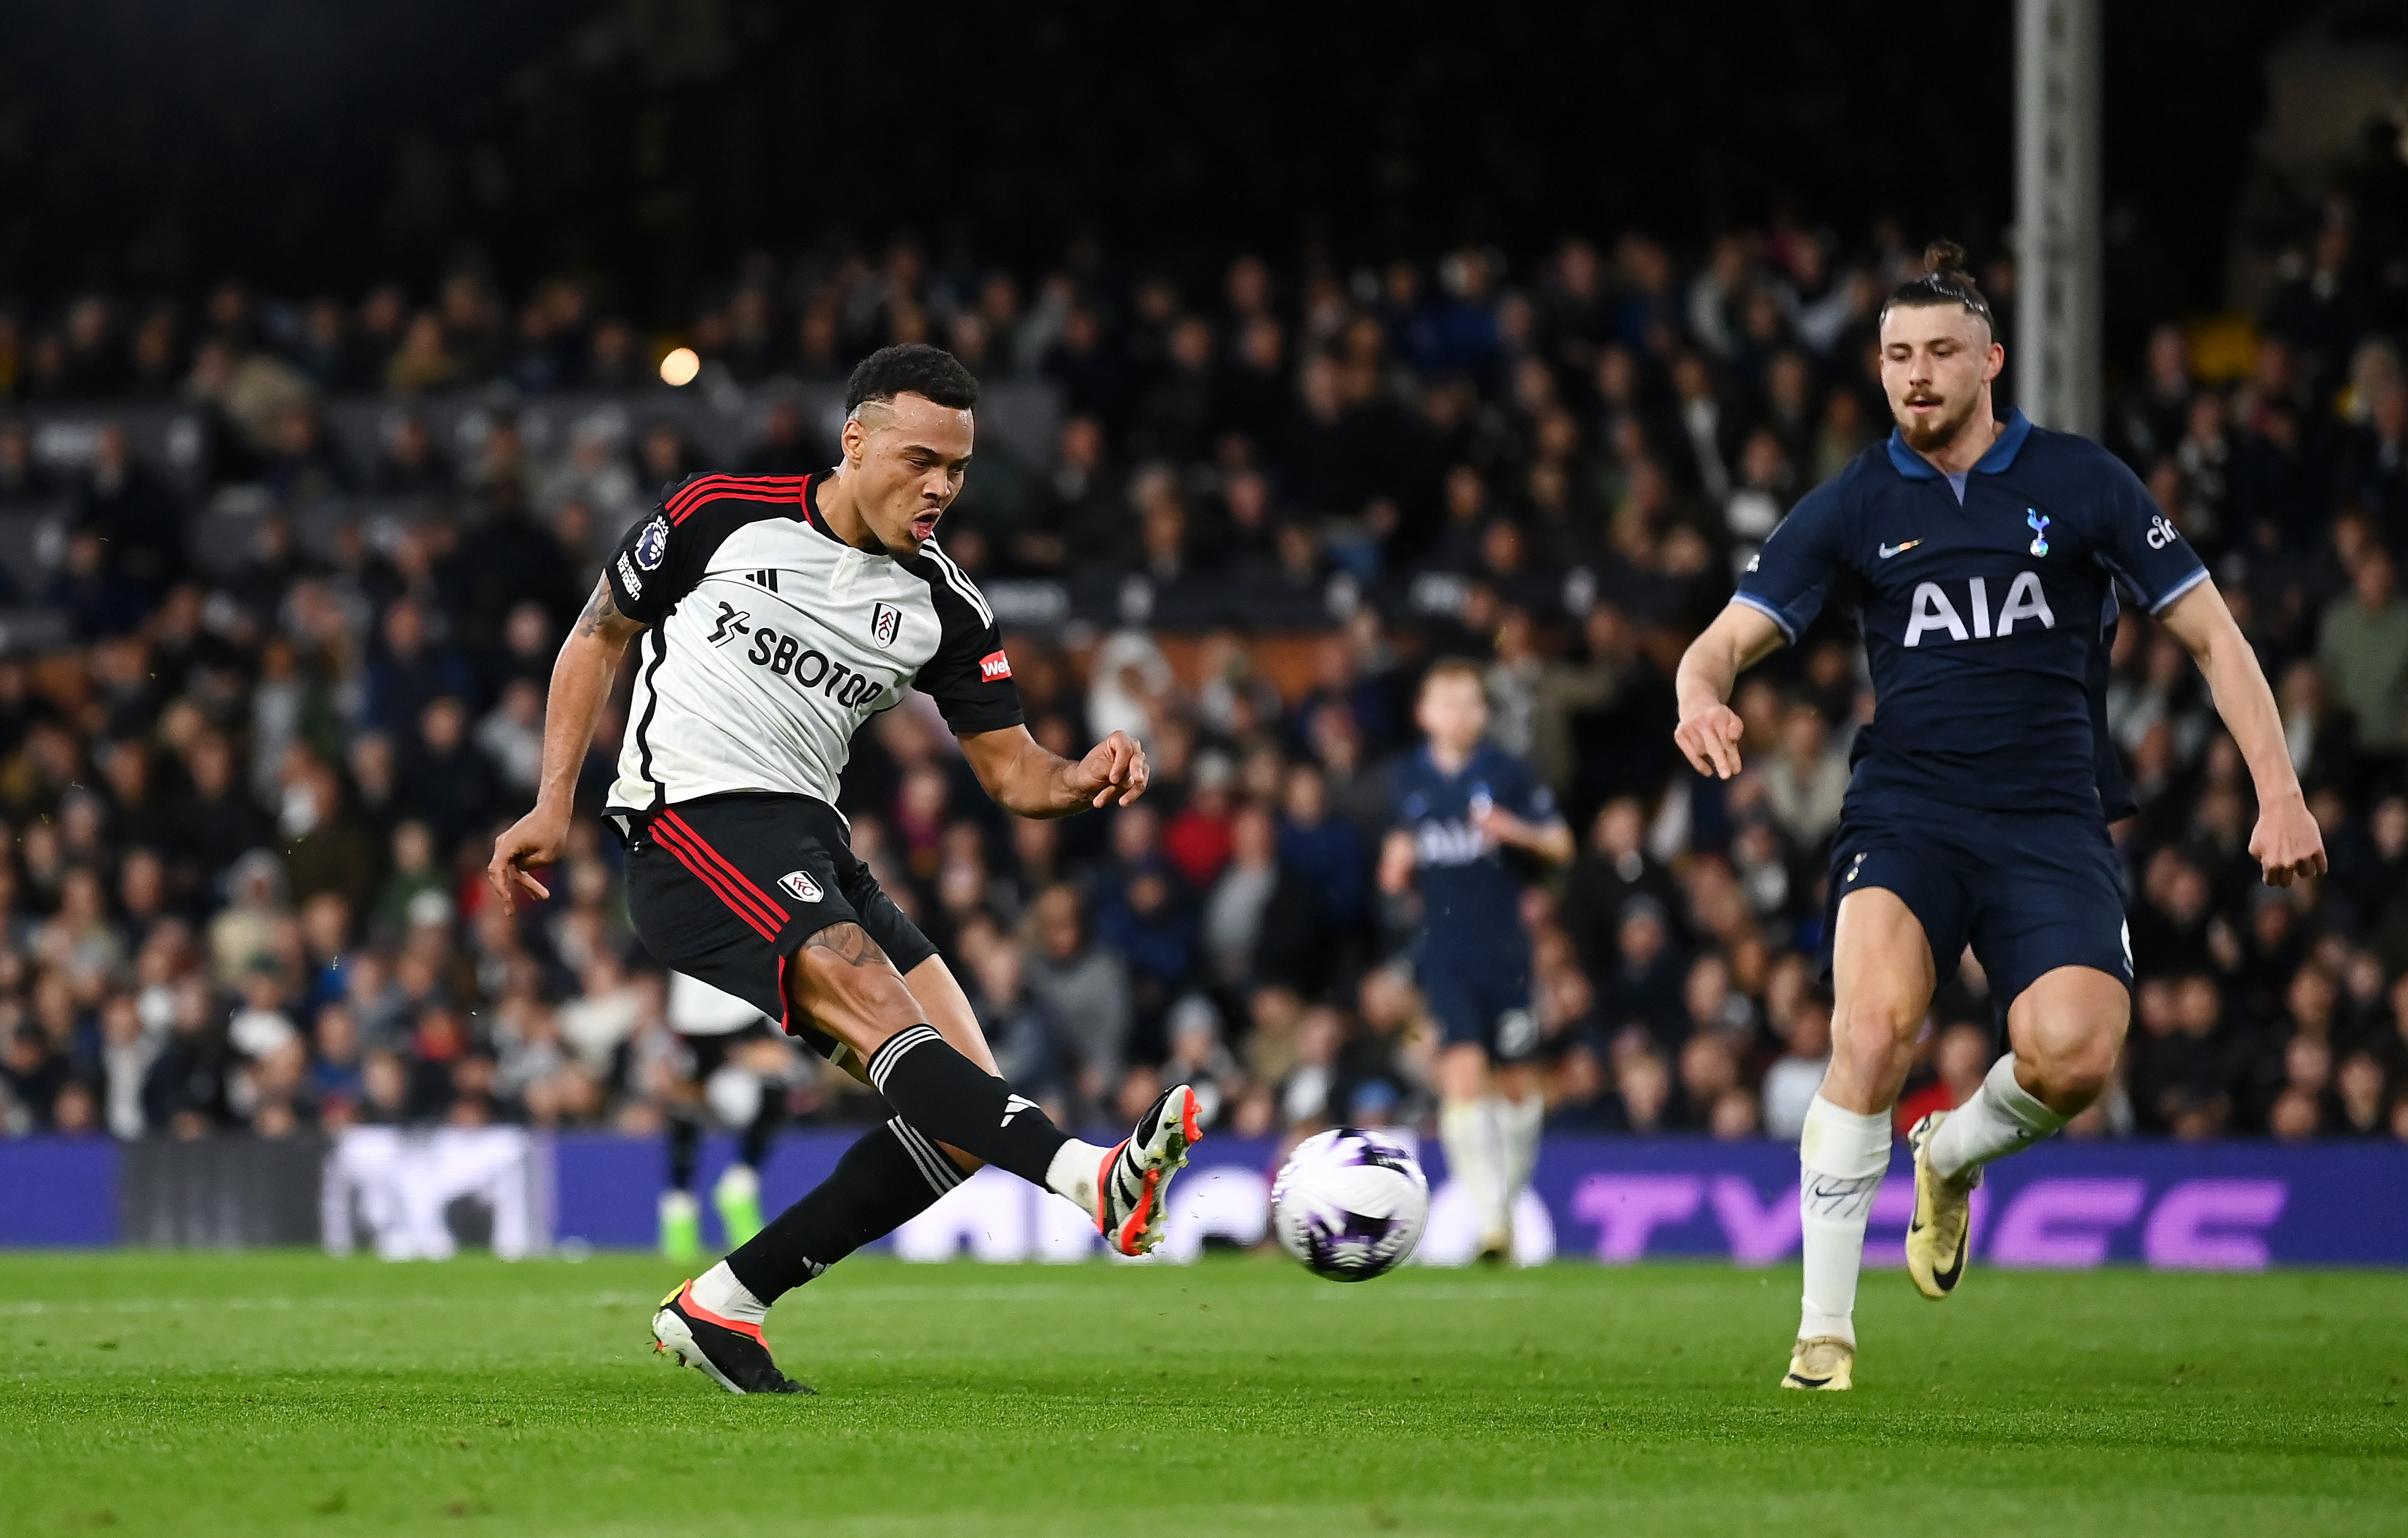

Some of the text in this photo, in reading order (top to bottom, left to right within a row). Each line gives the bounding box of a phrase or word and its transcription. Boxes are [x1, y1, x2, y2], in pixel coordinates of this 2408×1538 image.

[621, 571, 640, 601] racism
[627, 565, 642, 592] room
[1903, 570, 2056, 648] AIA
[878, 611, 894, 640] FFC
[748, 628, 883, 713] SBOTOP
[793, 877, 815, 896] FFC
